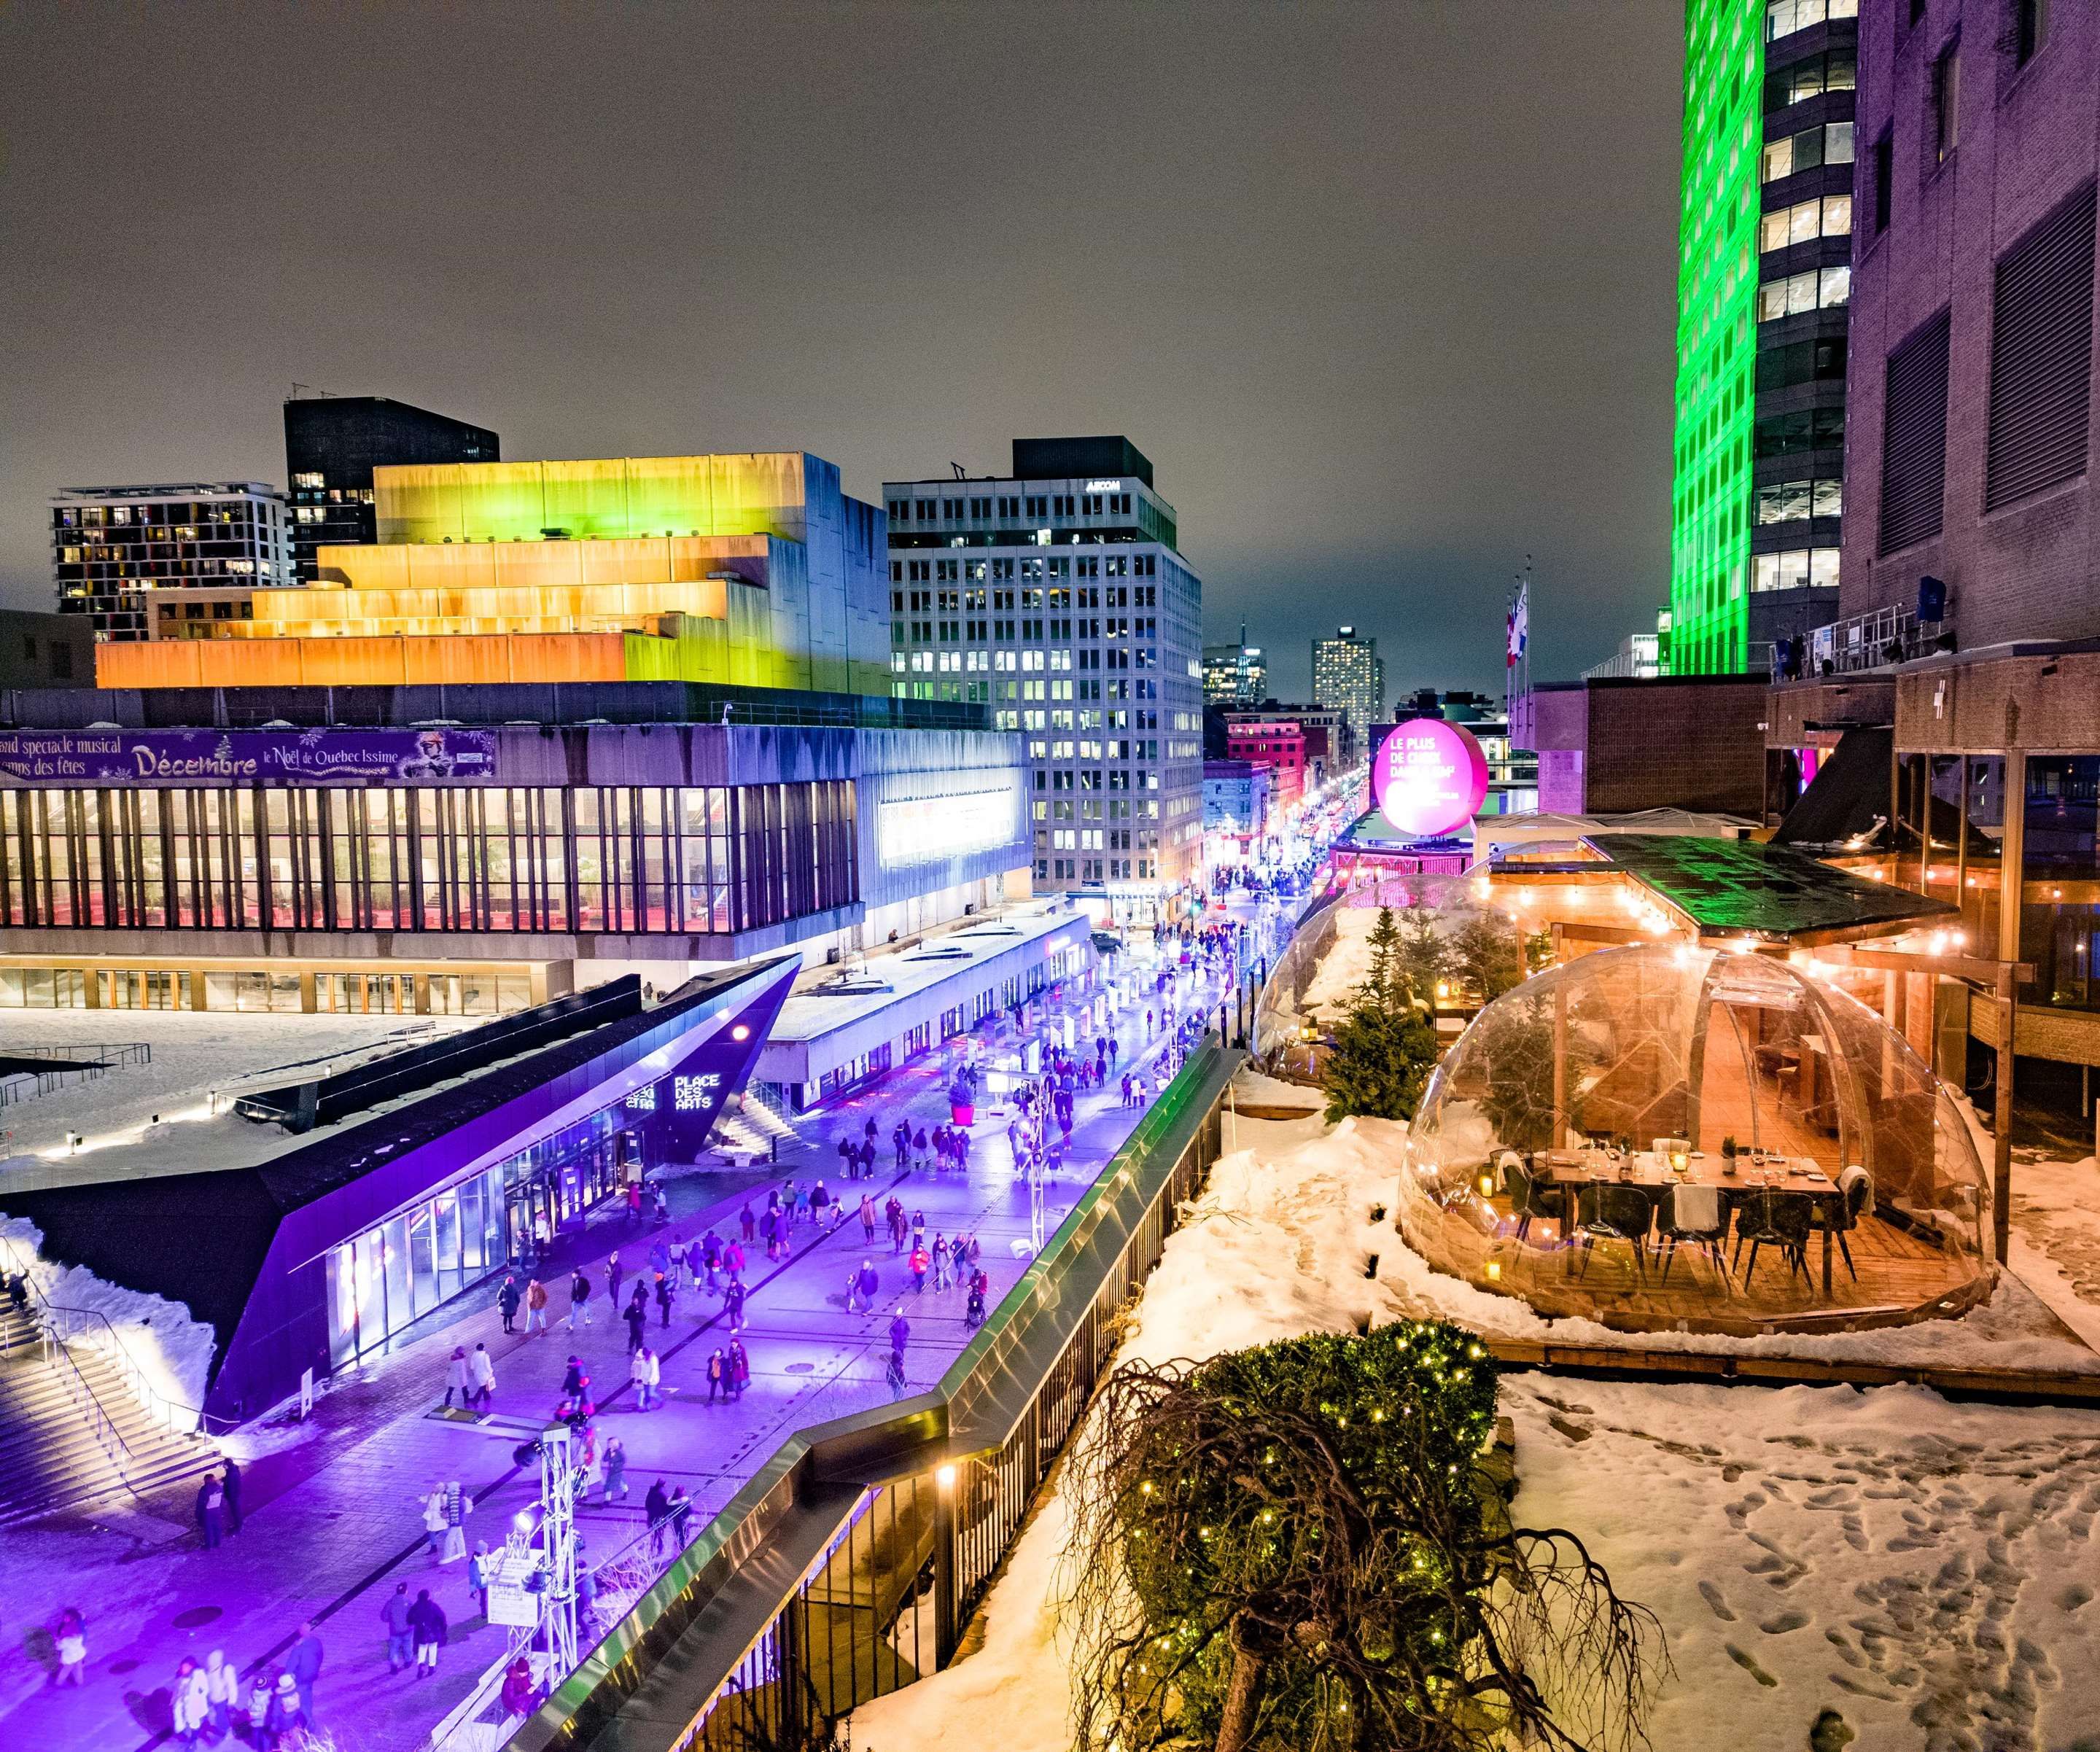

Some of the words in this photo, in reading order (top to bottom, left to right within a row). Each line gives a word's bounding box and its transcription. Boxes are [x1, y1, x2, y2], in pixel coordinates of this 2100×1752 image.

[23, 735, 73, 758] spectacle
[77, 735, 121, 753] musical
[1391, 738, 1404, 750] LE
[1407, 737, 1435, 750] PLUS
[131, 744, 257, 777] Décembre
[263, 752, 271, 763] le
[272, 746, 300, 770] Noël
[303, 752, 312, 763] de
[1390, 752, 1404, 764] DE
[34, 758, 54, 775] des
[58, 756, 85, 774] fêtes
[674, 1074, 720, 1088] PLACE
[674, 1087, 703, 1099] DES
[675, 1096, 712, 1110] ARTS
